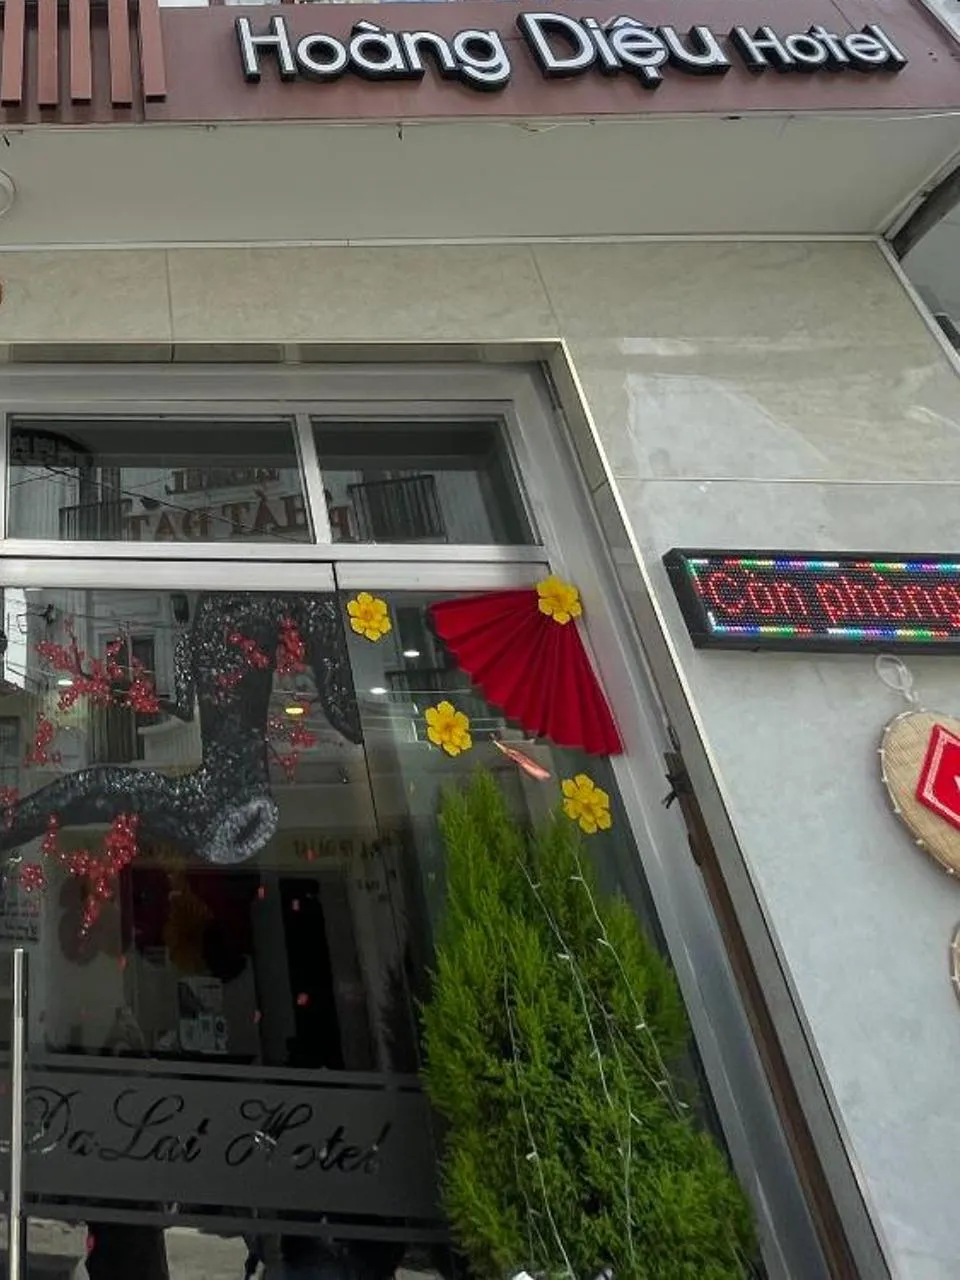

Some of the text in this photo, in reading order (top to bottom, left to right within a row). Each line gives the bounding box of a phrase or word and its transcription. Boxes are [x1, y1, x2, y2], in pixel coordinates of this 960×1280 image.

[235, 11, 908, 91] Hoàng Diệu Hotel
[708, 570, 807, 616] Còn
